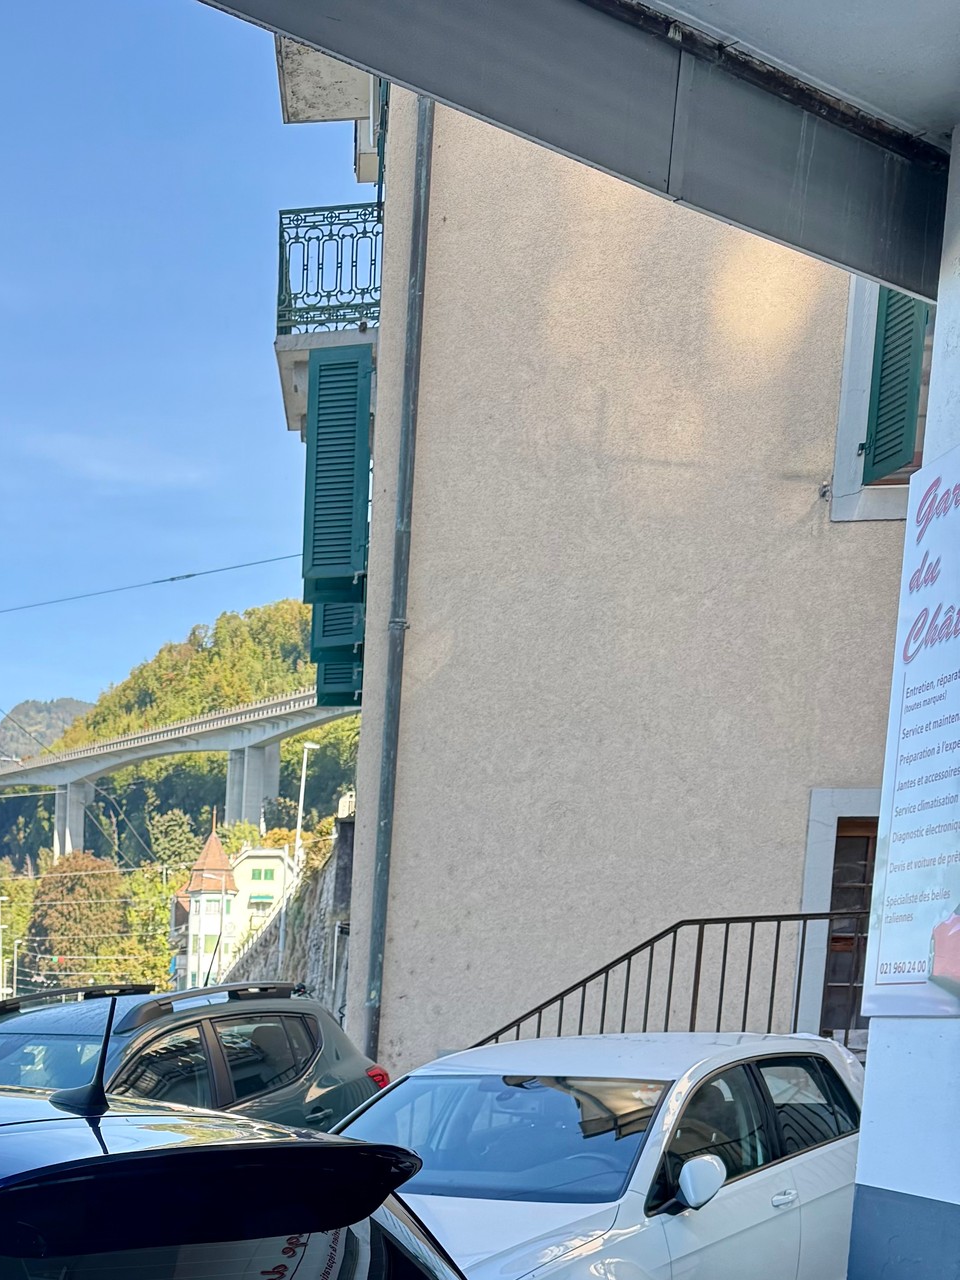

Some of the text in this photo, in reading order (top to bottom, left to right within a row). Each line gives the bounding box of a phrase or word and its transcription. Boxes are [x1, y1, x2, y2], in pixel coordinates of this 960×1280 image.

[909, 550, 941, 593] du
[905, 681, 935, 699] Entretien,
[901, 713, 960, 740] Service et mainten
[899, 746, 935, 766] Préparation
[897, 779, 916, 792] Jantes
[894, 793, 959, 817] Service climatisation
[892, 826, 924, 844] Diagnostic
[889, 860, 906, 873] Devis
[914, 856, 937, 869] voiture
[937, 852, 946, 865] de
[886, 887, 951, 909] Spécialiste des belles
[880, 960, 927, 975] 021 960 24 00
